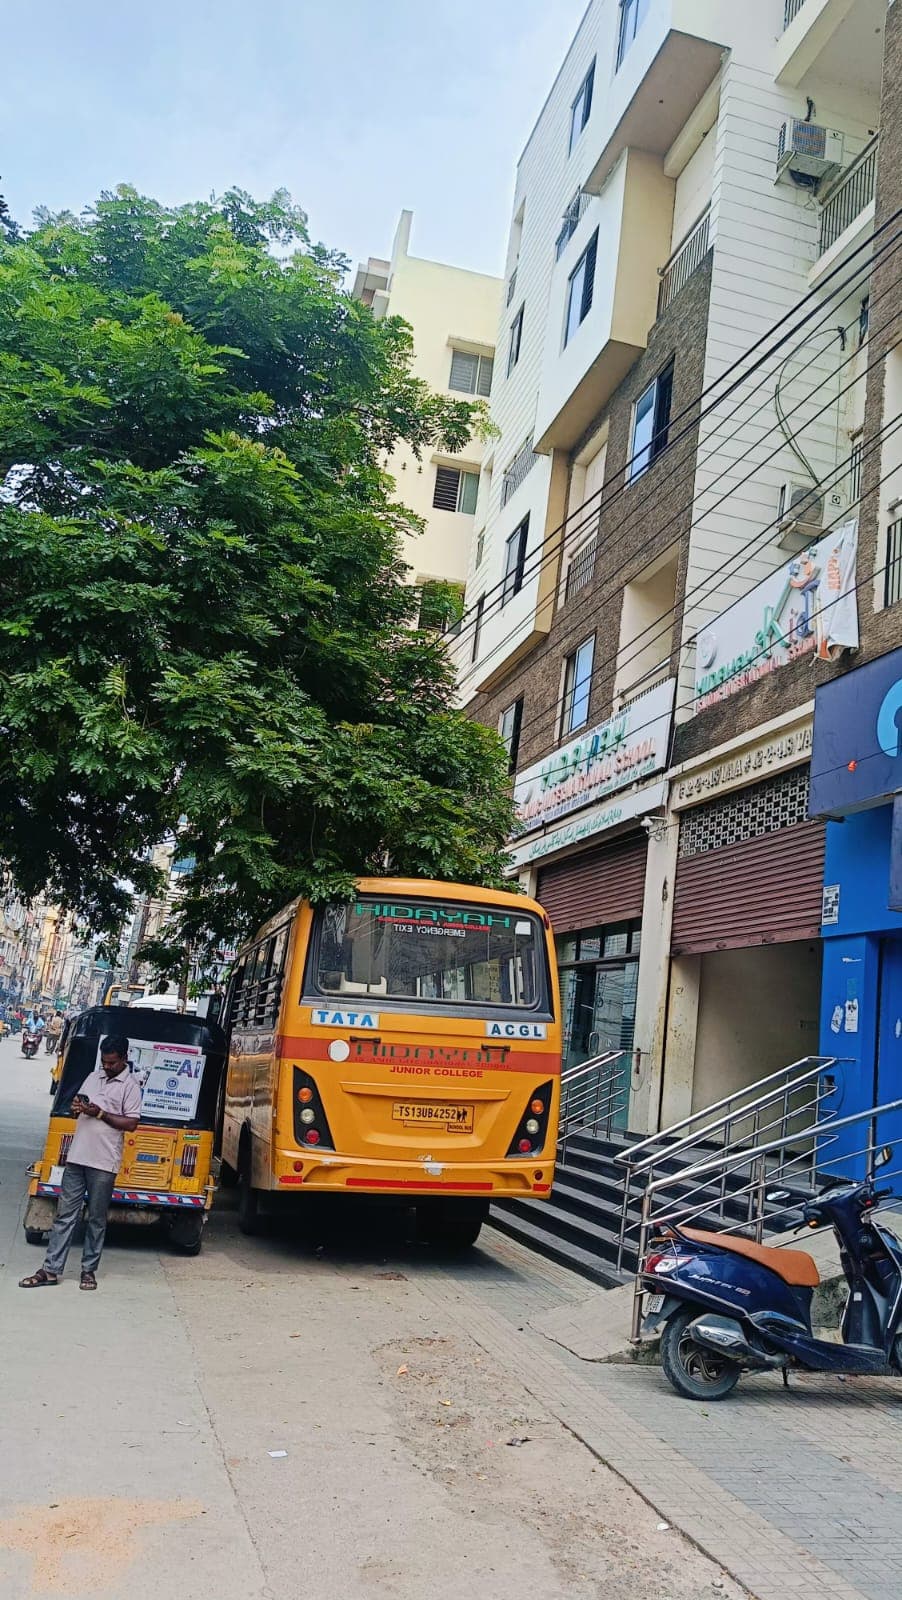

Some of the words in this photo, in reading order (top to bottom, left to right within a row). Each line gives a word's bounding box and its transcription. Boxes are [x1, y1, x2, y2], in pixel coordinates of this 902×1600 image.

[356, 903, 510, 928] HIDAYAH
[317, 1011, 373, 1026] TATA
[491, 1024, 542, 1037] ACGL
[390, 1066, 430, 1075] JUNIOR
[434, 1068, 483, 1078] COLLEGE
[399, 1106, 456, 1119] TS13UB4252
